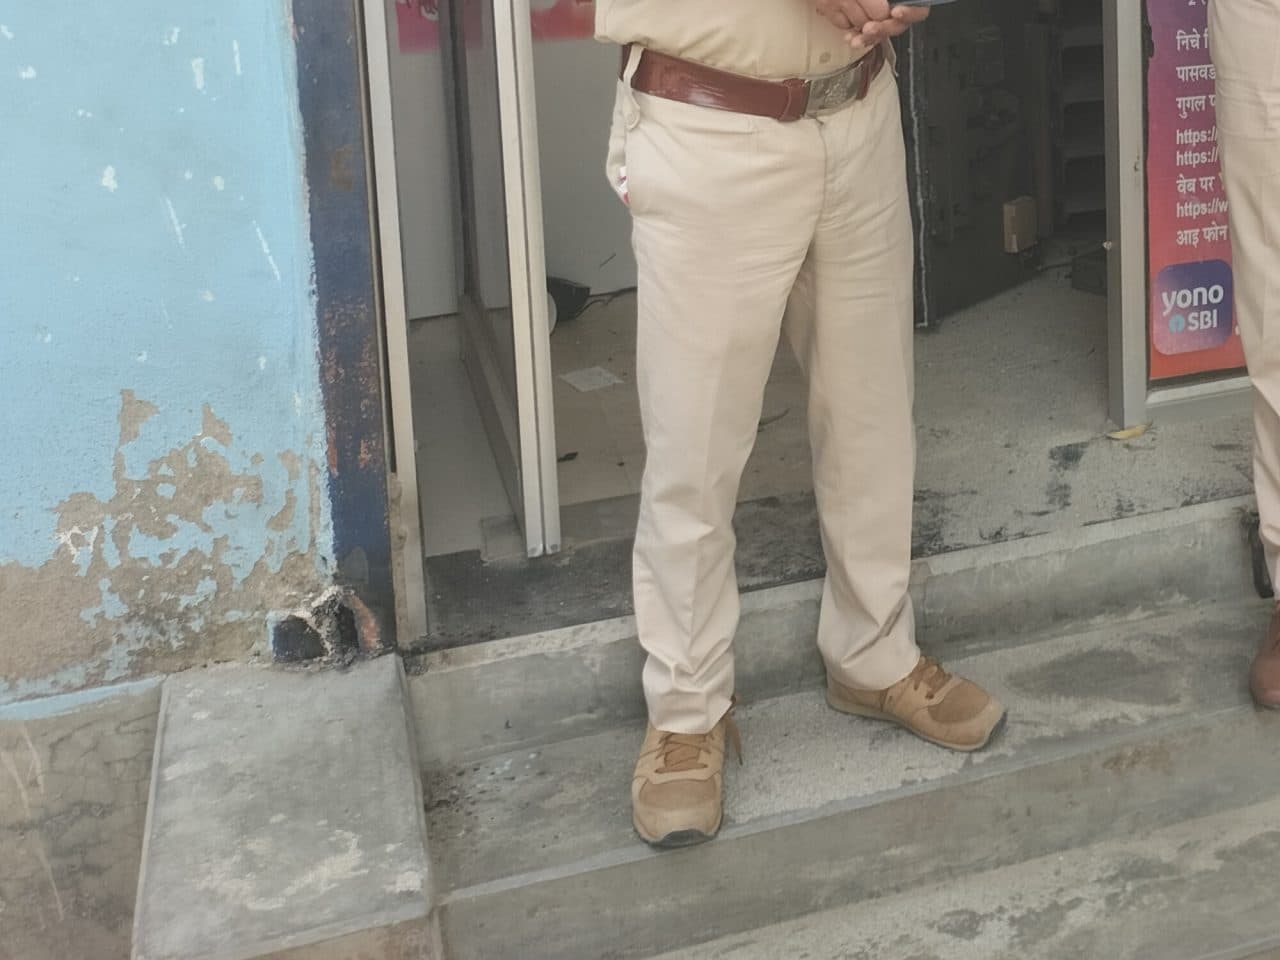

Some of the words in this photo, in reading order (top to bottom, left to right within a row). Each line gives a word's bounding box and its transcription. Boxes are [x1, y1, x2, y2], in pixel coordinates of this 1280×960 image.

[1176, 96, 1206, 119] गुगल
[1176, 173, 1196, 194] वेब
[1199, 175, 1215, 192] पर
[1202, 222, 1228, 242] फोन
[1162, 285, 1224, 315] yono
[1187, 309, 1217, 331] SBI
